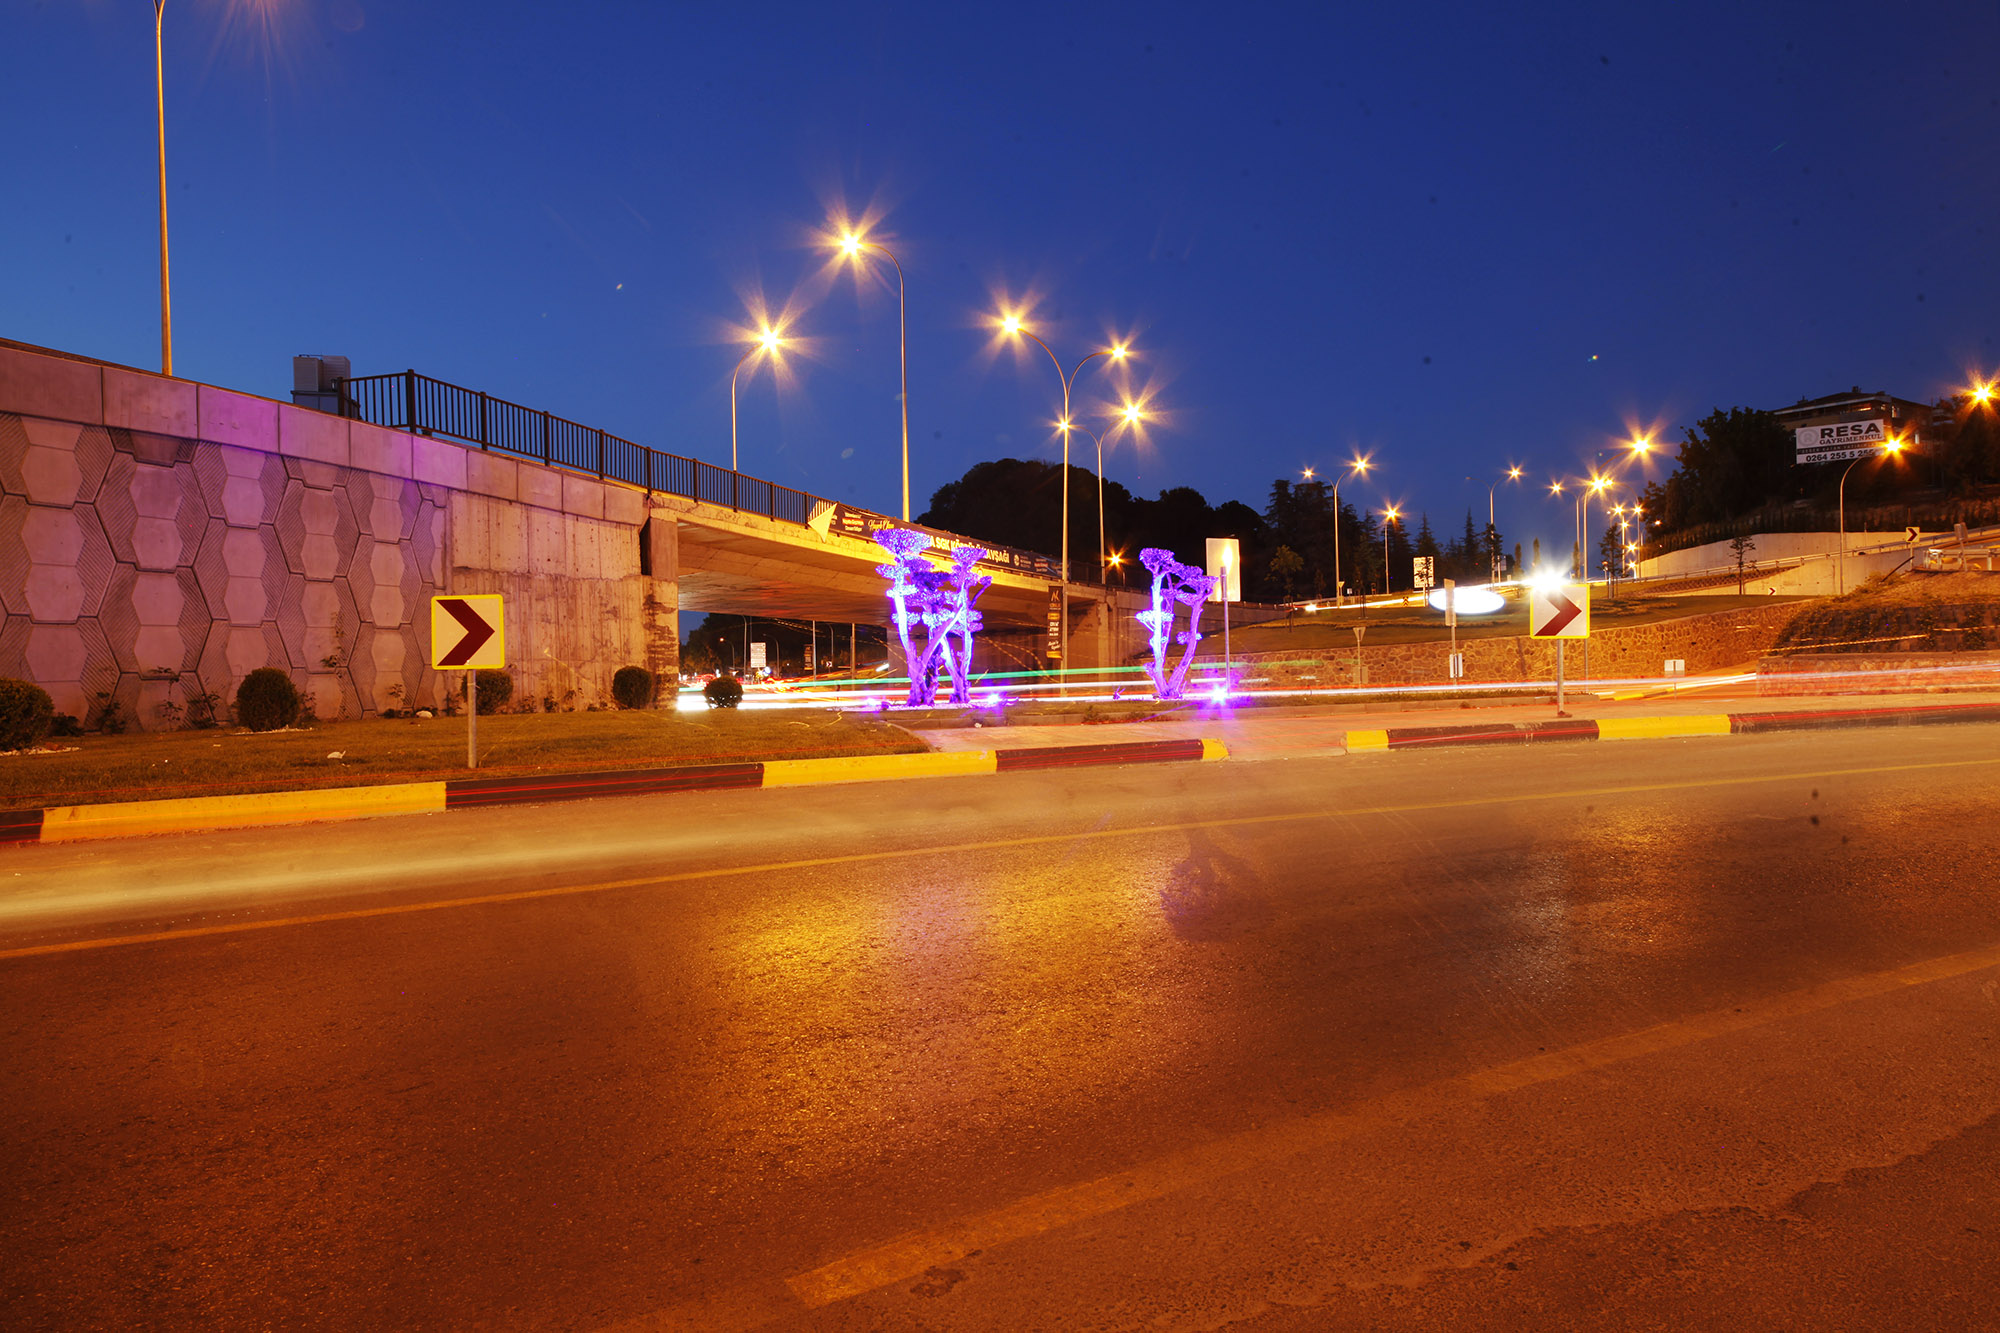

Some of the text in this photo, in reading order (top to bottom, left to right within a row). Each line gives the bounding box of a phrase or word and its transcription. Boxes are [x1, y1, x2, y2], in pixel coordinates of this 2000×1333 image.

[1820, 423, 1880, 439] RESA
[1806, 453, 1828, 462] 0264
[1830, 451, 1847, 459] 255
[1849, 450, 1855, 458] 5
[935, 537, 951, 551] SGK
[982, 546, 1010, 563] AVŞAĞI
